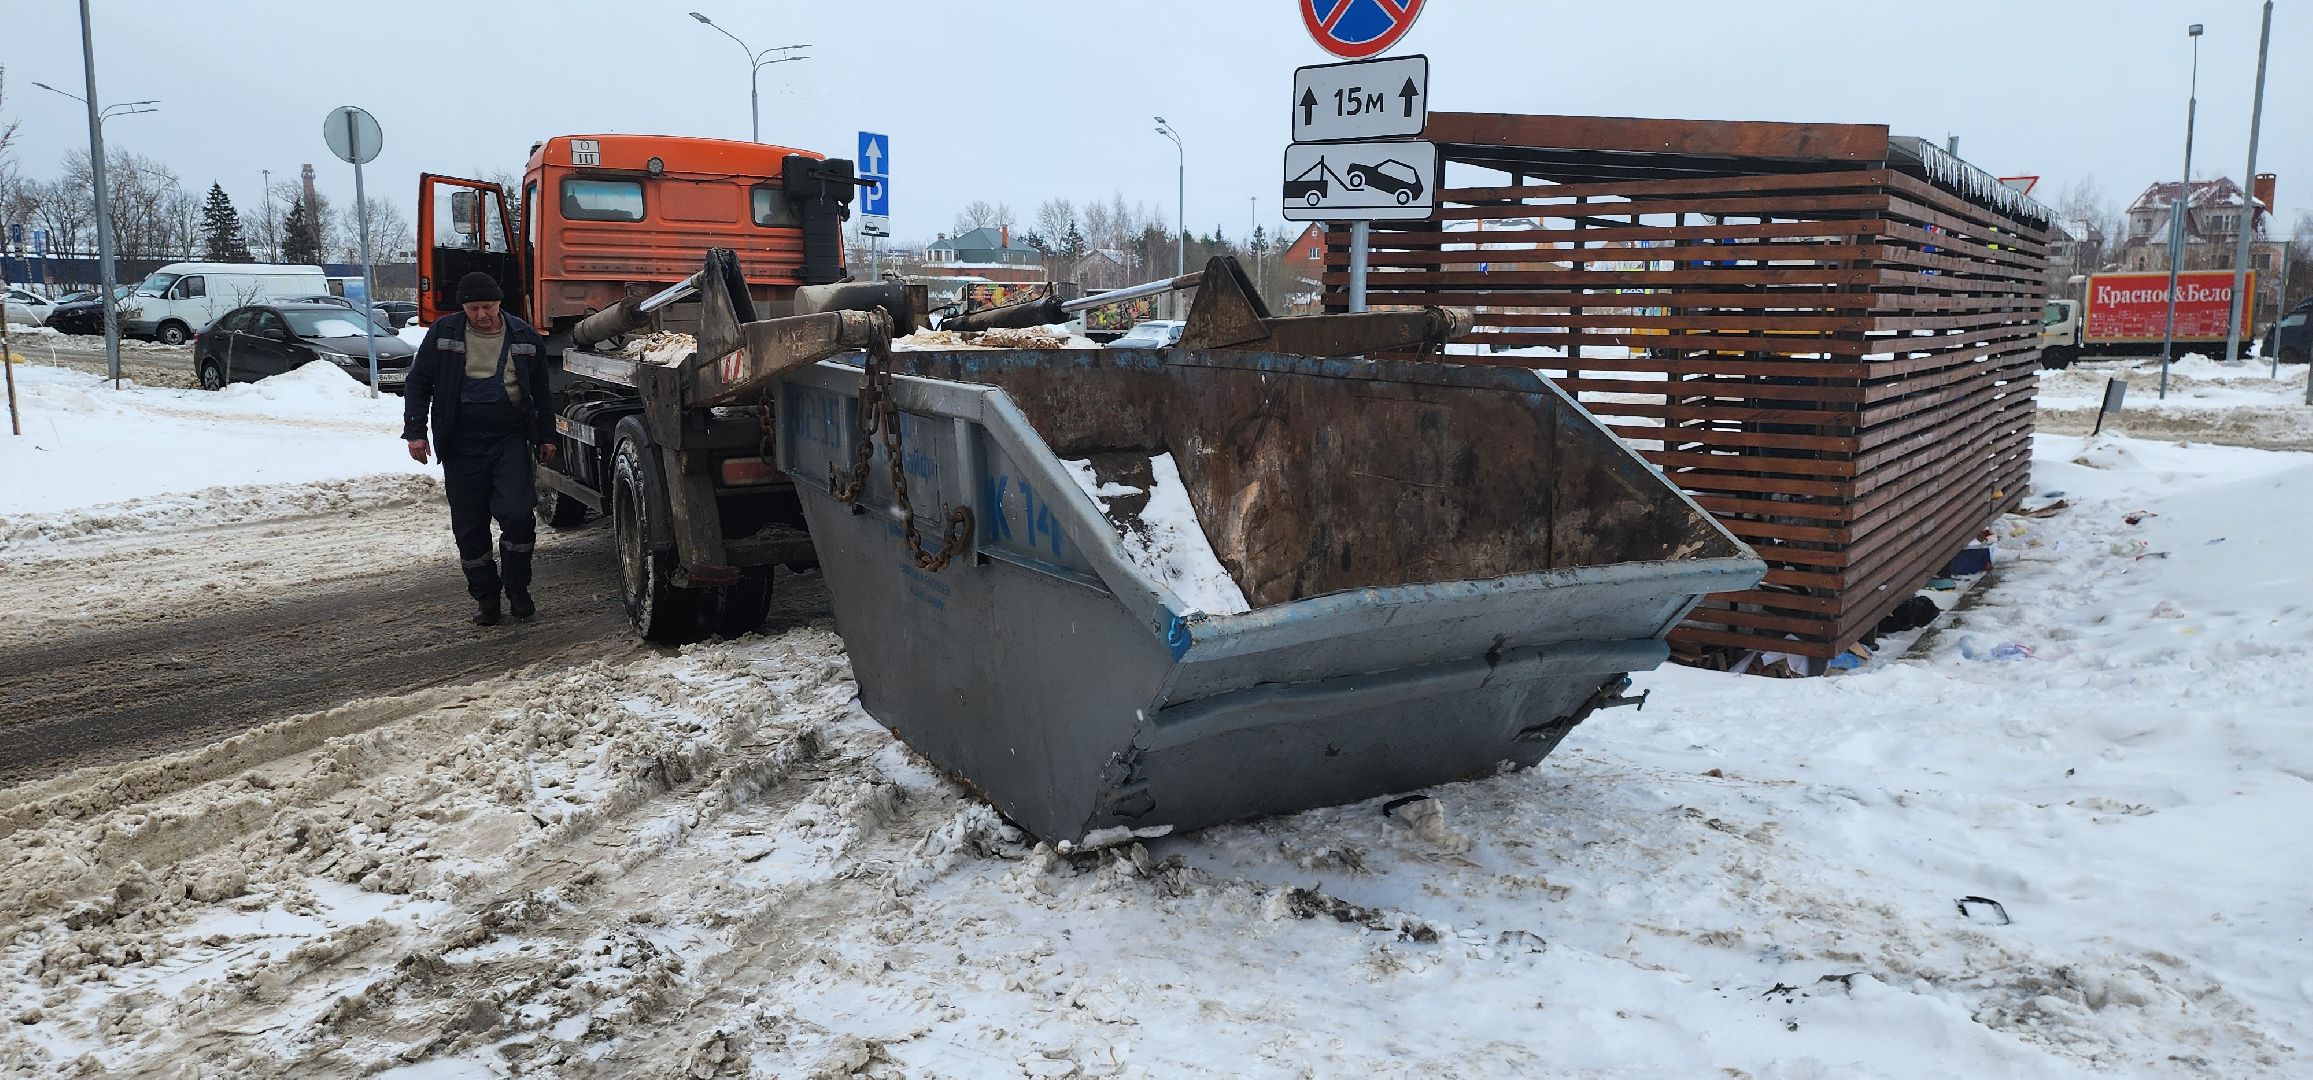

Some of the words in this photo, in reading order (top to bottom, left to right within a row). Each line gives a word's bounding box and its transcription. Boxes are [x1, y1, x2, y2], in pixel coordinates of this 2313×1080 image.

[1333, 86, 1384, 117] 15м
[866, 178, 883, 210] P
[2096, 283, 2232, 308] Красное&Бело
[1017, 479, 1062, 558] 14
